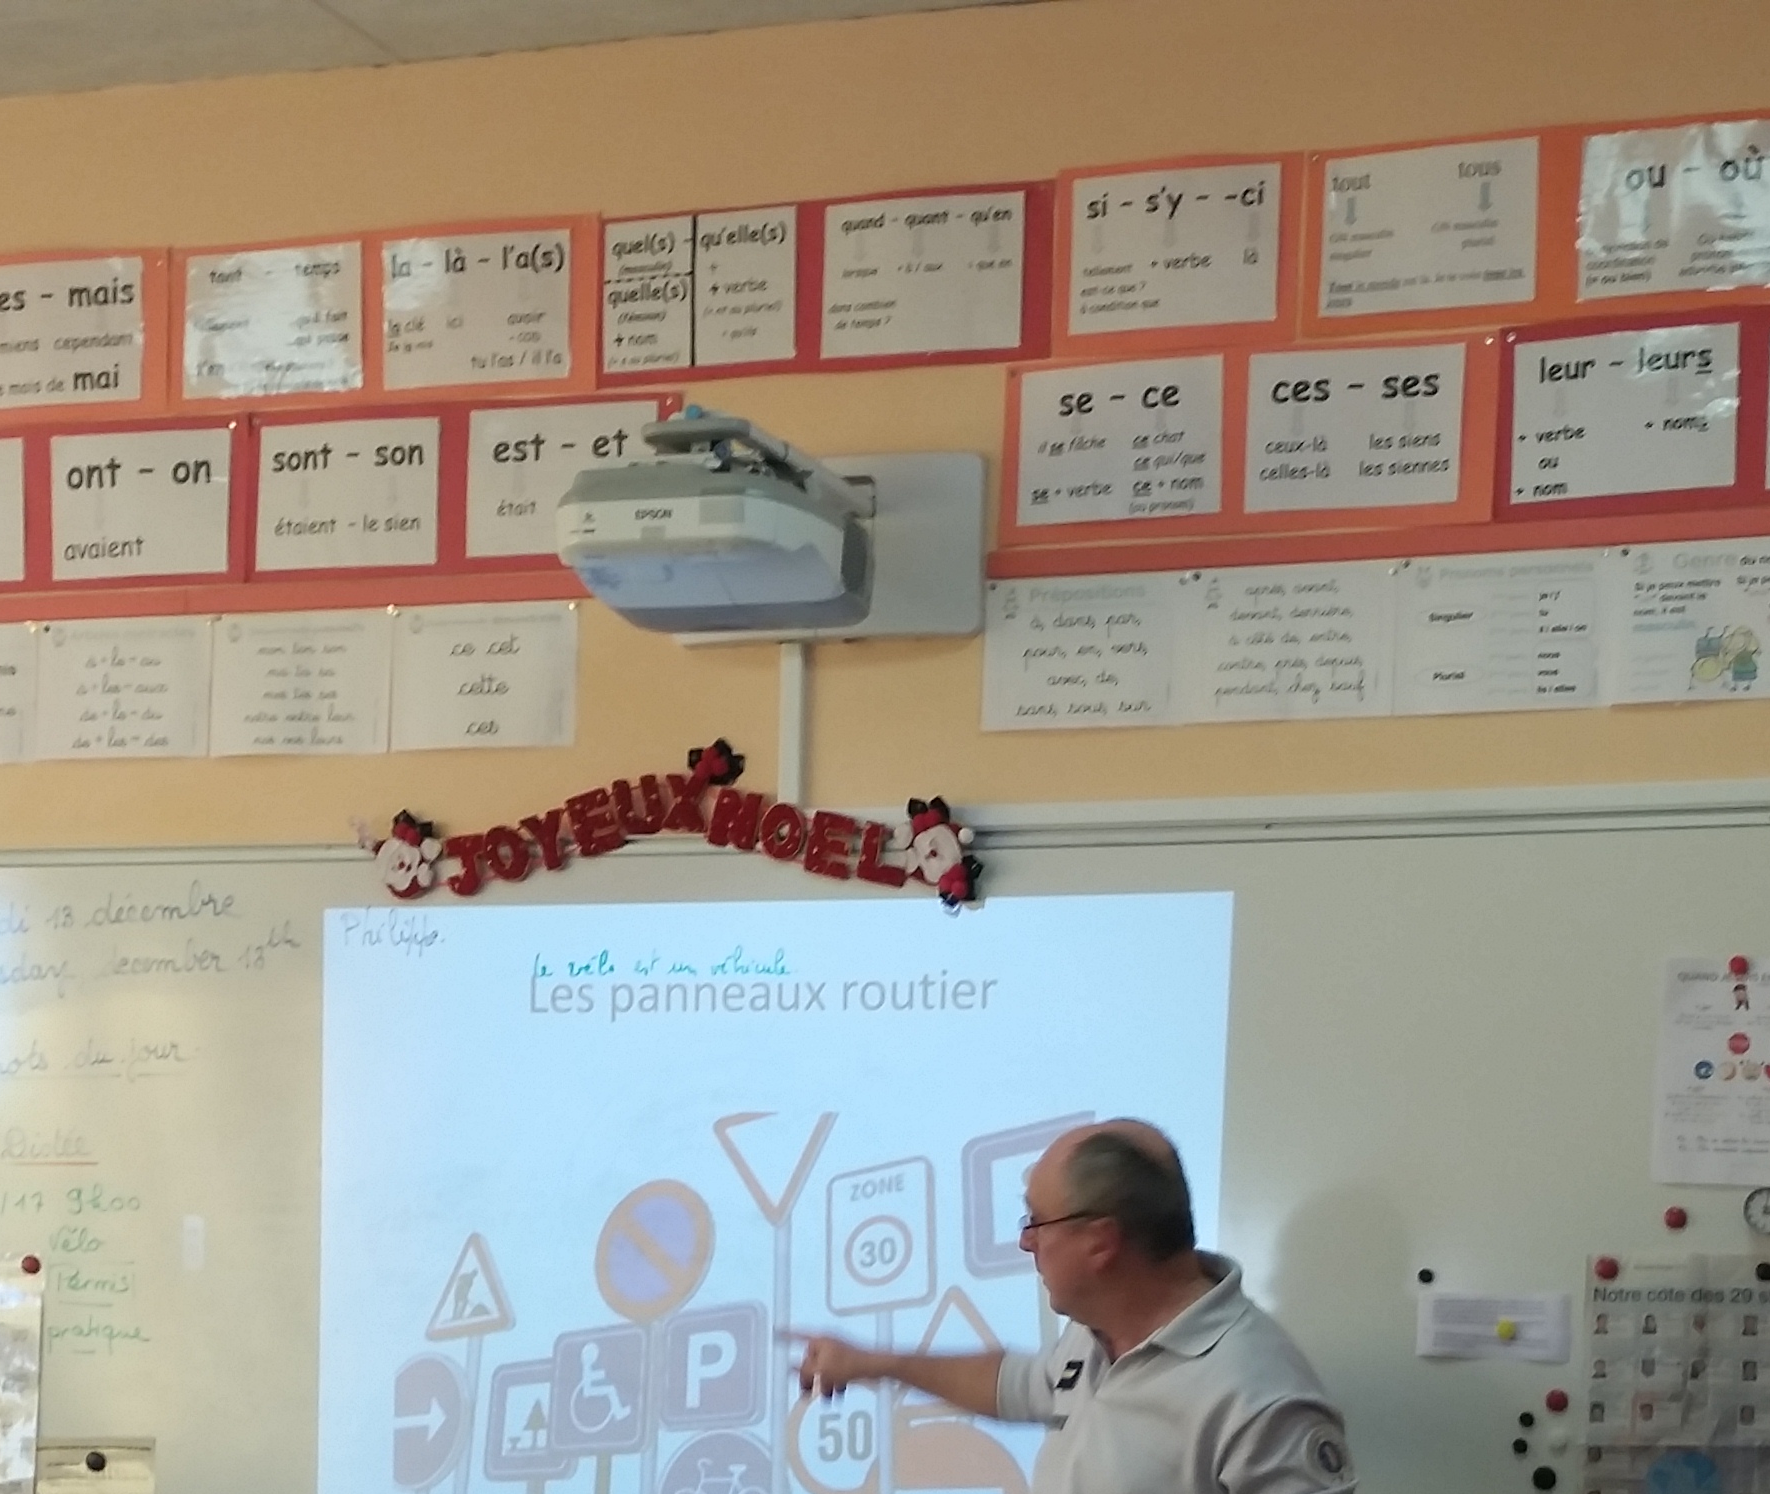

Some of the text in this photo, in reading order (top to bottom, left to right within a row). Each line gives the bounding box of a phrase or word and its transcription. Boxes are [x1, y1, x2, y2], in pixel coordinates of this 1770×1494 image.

[1625, 144, 1763, 190] ou où
[1087, 187, 1182, 220] si s'y
[841, 206, 1012, 234] quand quant qu'en
[612, 222, 787, 258] quel(s) qu'elle(s)
[391, 244, 565, 278] la là l'a(s)
[1164, 254, 1211, 270] verbe
[68, 277, 134, 308] mais
[608, 282, 688, 306] quelle(s)
[54, 333, 133, 351] cependant
[73, 365, 120, 391] mai
[1539, 346, 1713, 383] leur leurs
[1059, 385, 1179, 417] se ce
[1272, 373, 1439, 404] ces ses
[493, 429, 628, 462] est et
[1535, 424, 1585, 443] verbe
[272, 442, 423, 472] sont son
[67, 458, 212, 489] ont on
[1533, 480, 1567, 497] nom
[64, 537, 144, 561] avaient
[444, 773, 909, 896] JOYEUX NOEL
[531, 974, 998, 1022] Les panneaux routier
[850, 1174, 906, 1201] ZONE
[859, 1237, 897, 1268] 30
[687, 1330, 736, 1408] P
[817, 1409, 874, 1462] 50
